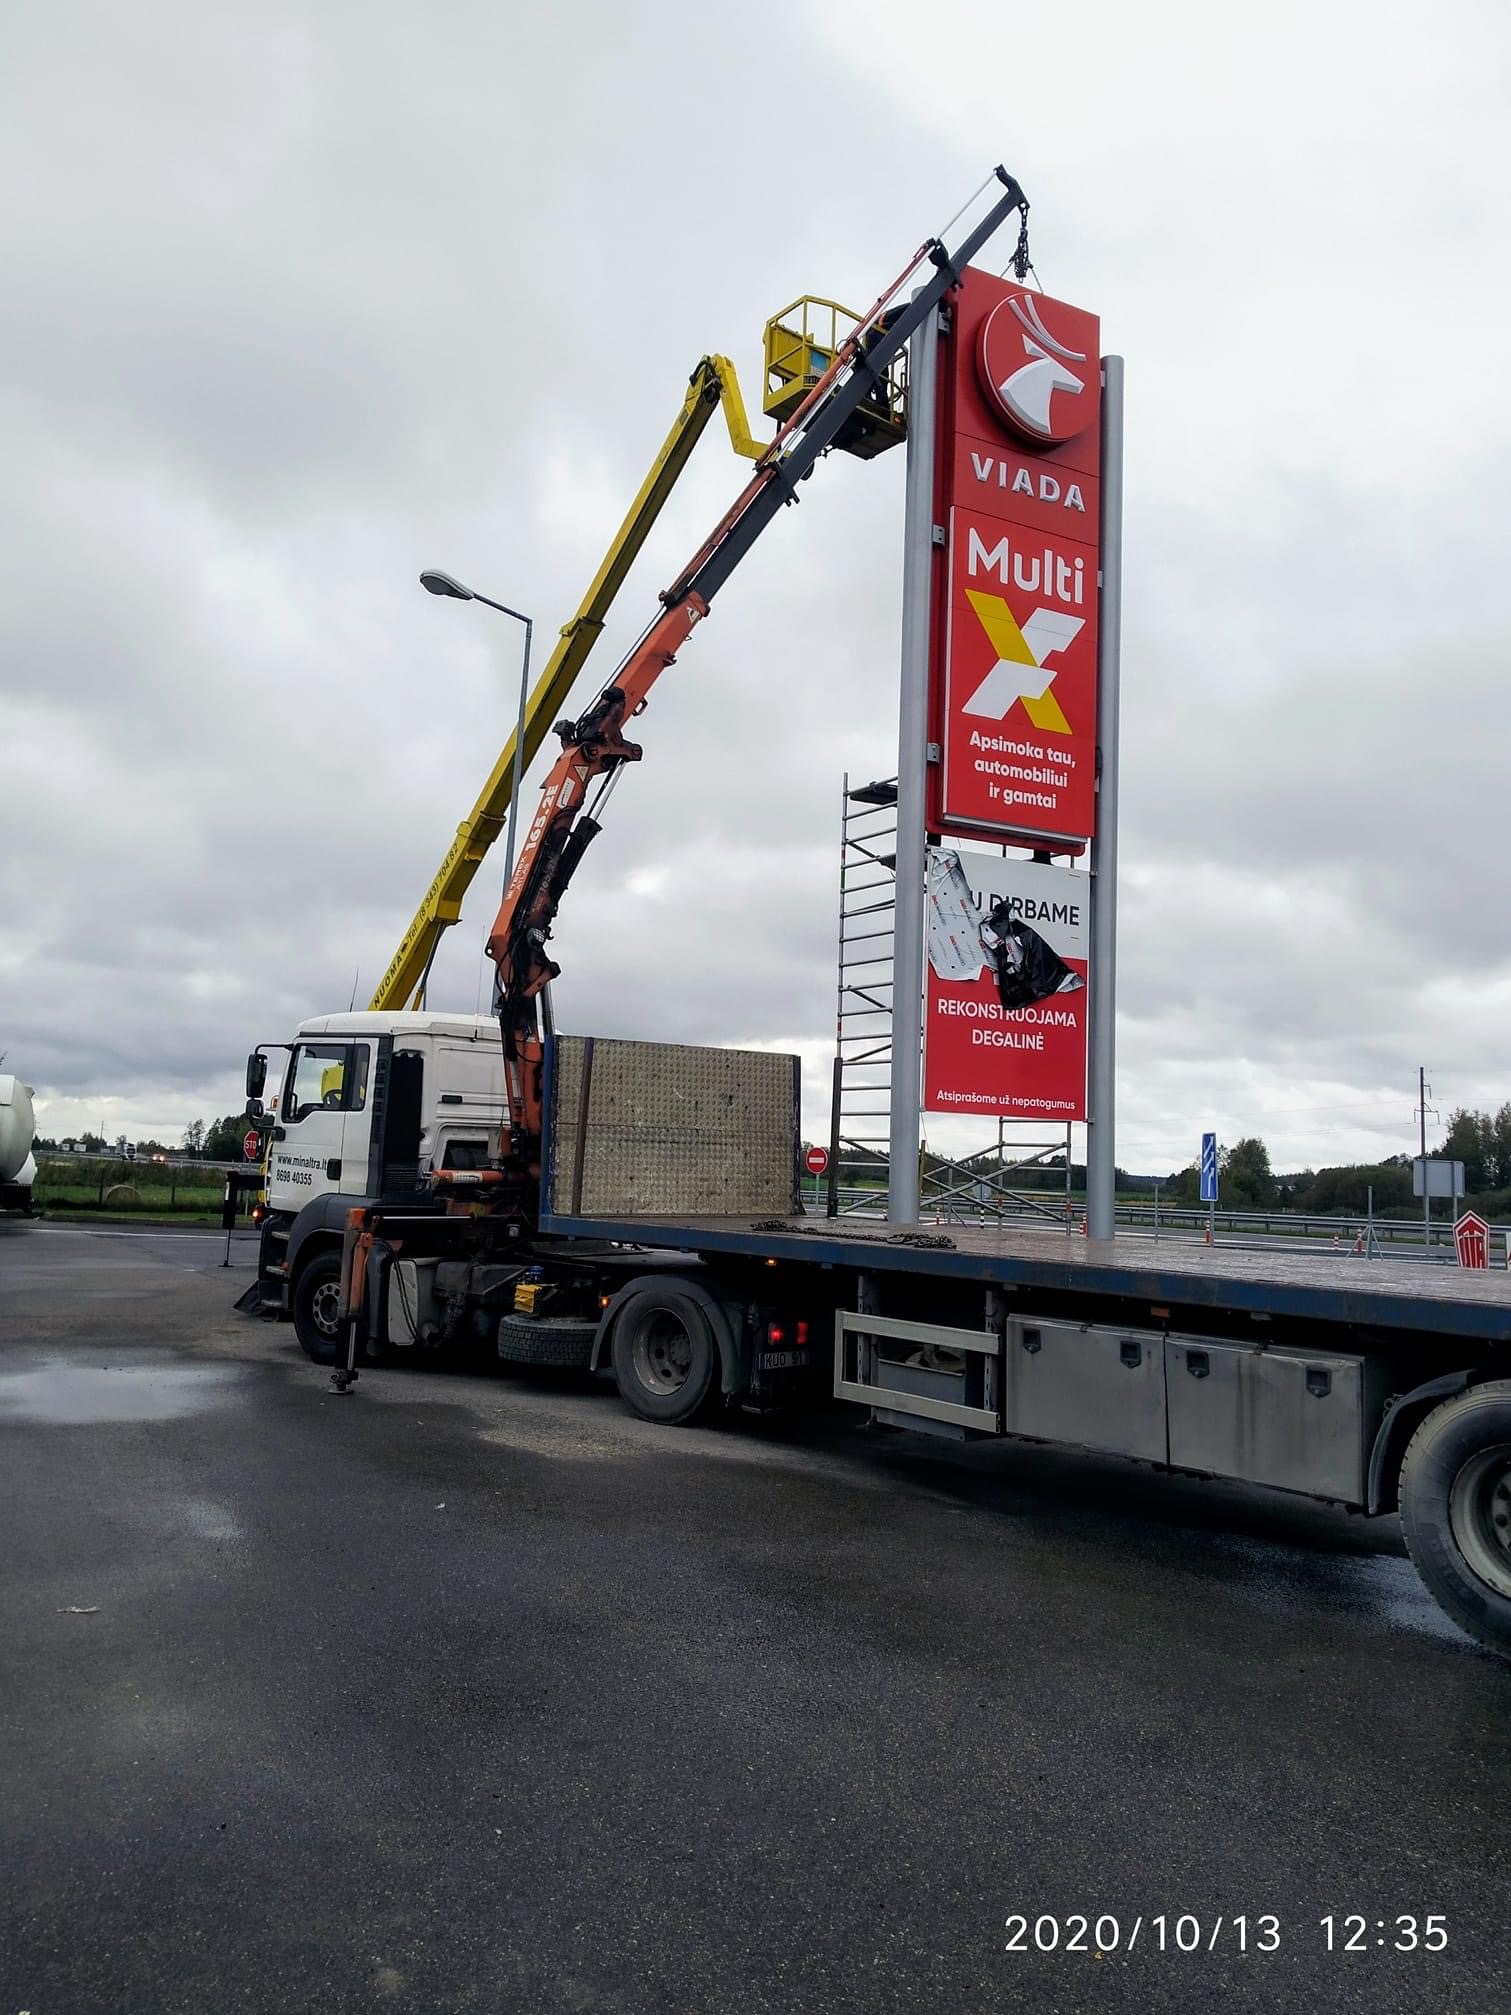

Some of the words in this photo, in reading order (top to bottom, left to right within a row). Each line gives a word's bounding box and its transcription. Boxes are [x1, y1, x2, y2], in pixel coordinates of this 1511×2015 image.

[970, 452, 1086, 512] VIADA
[967, 527, 1085, 604] Multi
[969, 730, 1043, 759] Apsimoka
[1046, 747, 1076, 768] tau,
[974, 759, 1068, 787] automobiliui
[989, 782, 1000, 798] ir
[1003, 789, 1057, 809] gamtai
[990, 893, 1080, 926] DRBAME
[374, 956, 403, 1010] NUOMA
[937, 998, 1077, 1028] REKONSTRUOJAMA
[972, 1029, 1044, 1050] DEGALINĖ
[937, 1089, 997, 1104] Atsiprašome
[999, 1094, 1010, 1105] už
[1012, 1097, 1076, 1110] nepatogumus
[245, 1140, 258, 1150] STO
[277, 1155, 327, 1171] www.minaltra.lt
[292, 1171, 312, 1186] 40355
